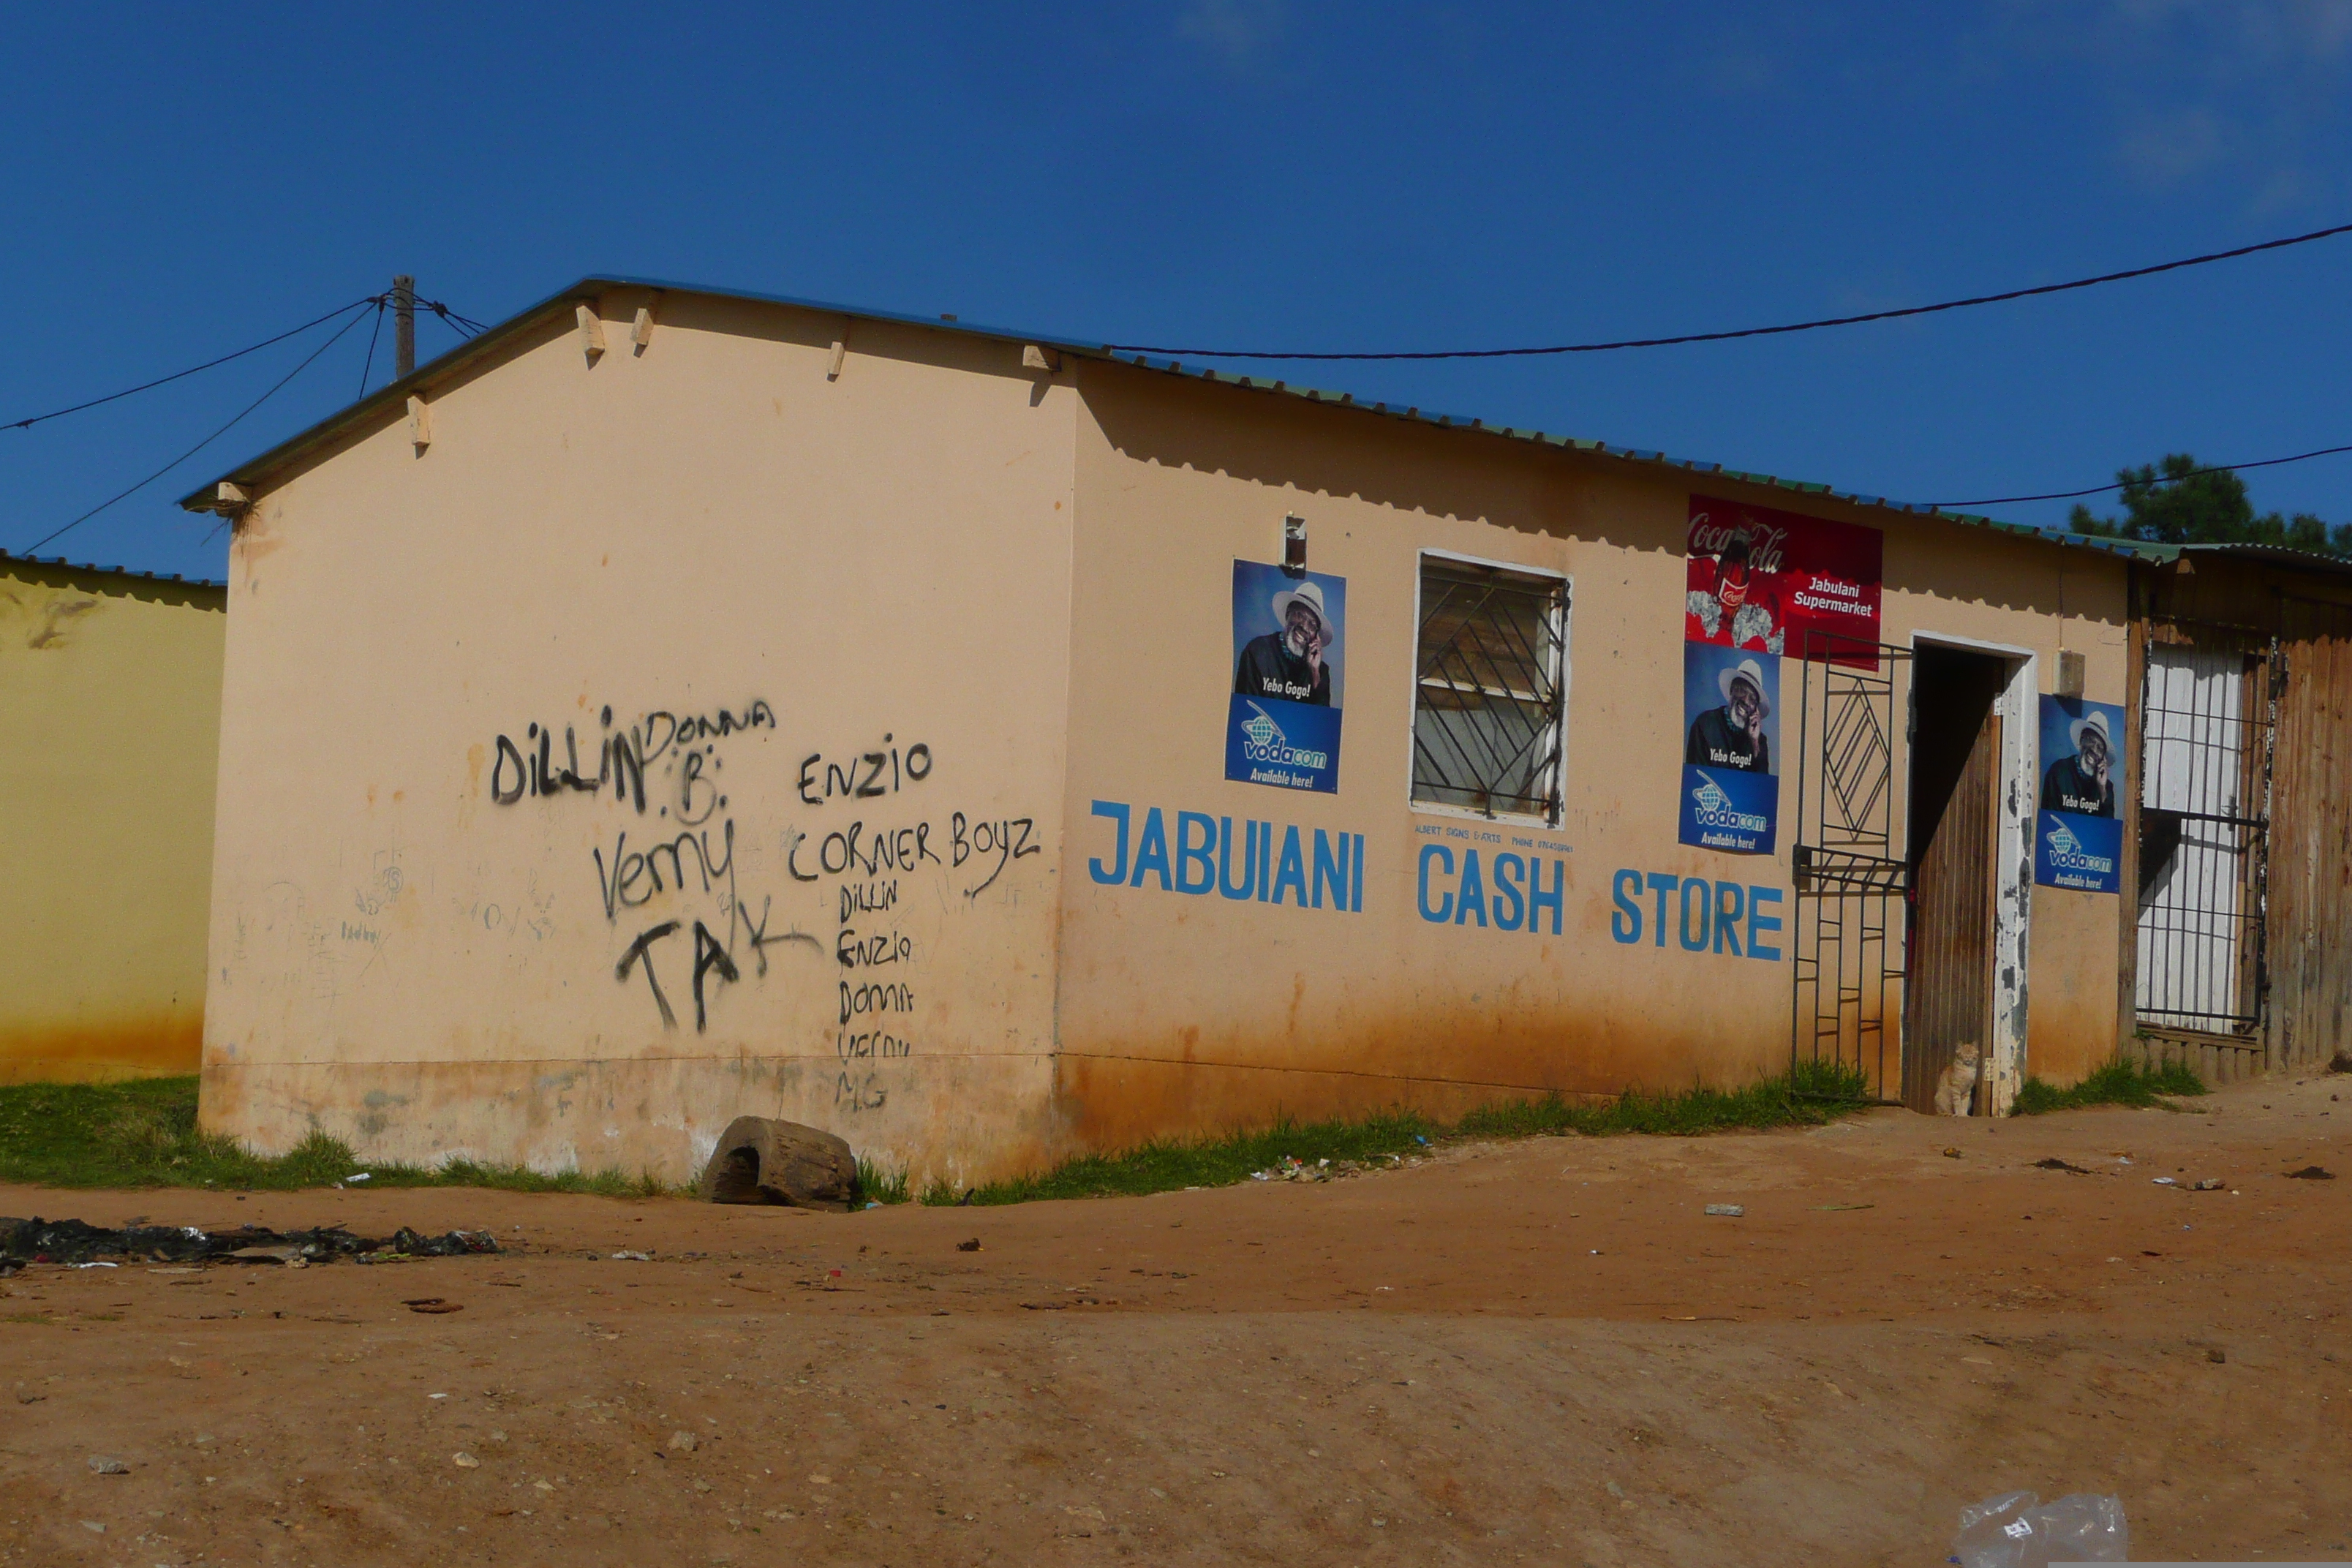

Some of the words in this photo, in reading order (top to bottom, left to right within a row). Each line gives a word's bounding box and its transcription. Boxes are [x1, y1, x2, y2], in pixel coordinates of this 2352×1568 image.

[1688, 512, 1787, 574] Cocaola
[1809, 576, 1860, 598] Jabulani
[1794, 592, 1872, 617] Supermarket
[1262, 677, 1283, 693] Yebo
[1285, 681, 1311, 699] Gogo!
[1244, 739, 1327, 769] vodacom
[1710, 748, 1727, 763] Yebo
[1730, 752, 1752, 768] Gogo!
[1250, 767, 1289, 785] Available
[1291, 772, 1313, 788] here!
[2062, 794, 2078, 808] Yebo
[2079, 797, 2100, 813] Gogo!
[1695, 804, 1767, 832] vodacom
[1414, 824, 1442, 836] ALBERT
[1446, 826, 1470, 840] SIGNS
[1480, 832, 1501, 844] ARTS
[1512, 836, 1534, 848] PHONE
[1701, 832, 1735, 847] Available
[1737, 836, 1756, 849] here!
[788, 821, 941, 881] CORNER
[2049, 846, 2112, 873] vodacom
[2054, 873, 2084, 887] Available
[2086, 876, 2102, 889] here!
[1417, 843, 1564, 935] CASH
[1611, 868, 1783, 962] STORE
